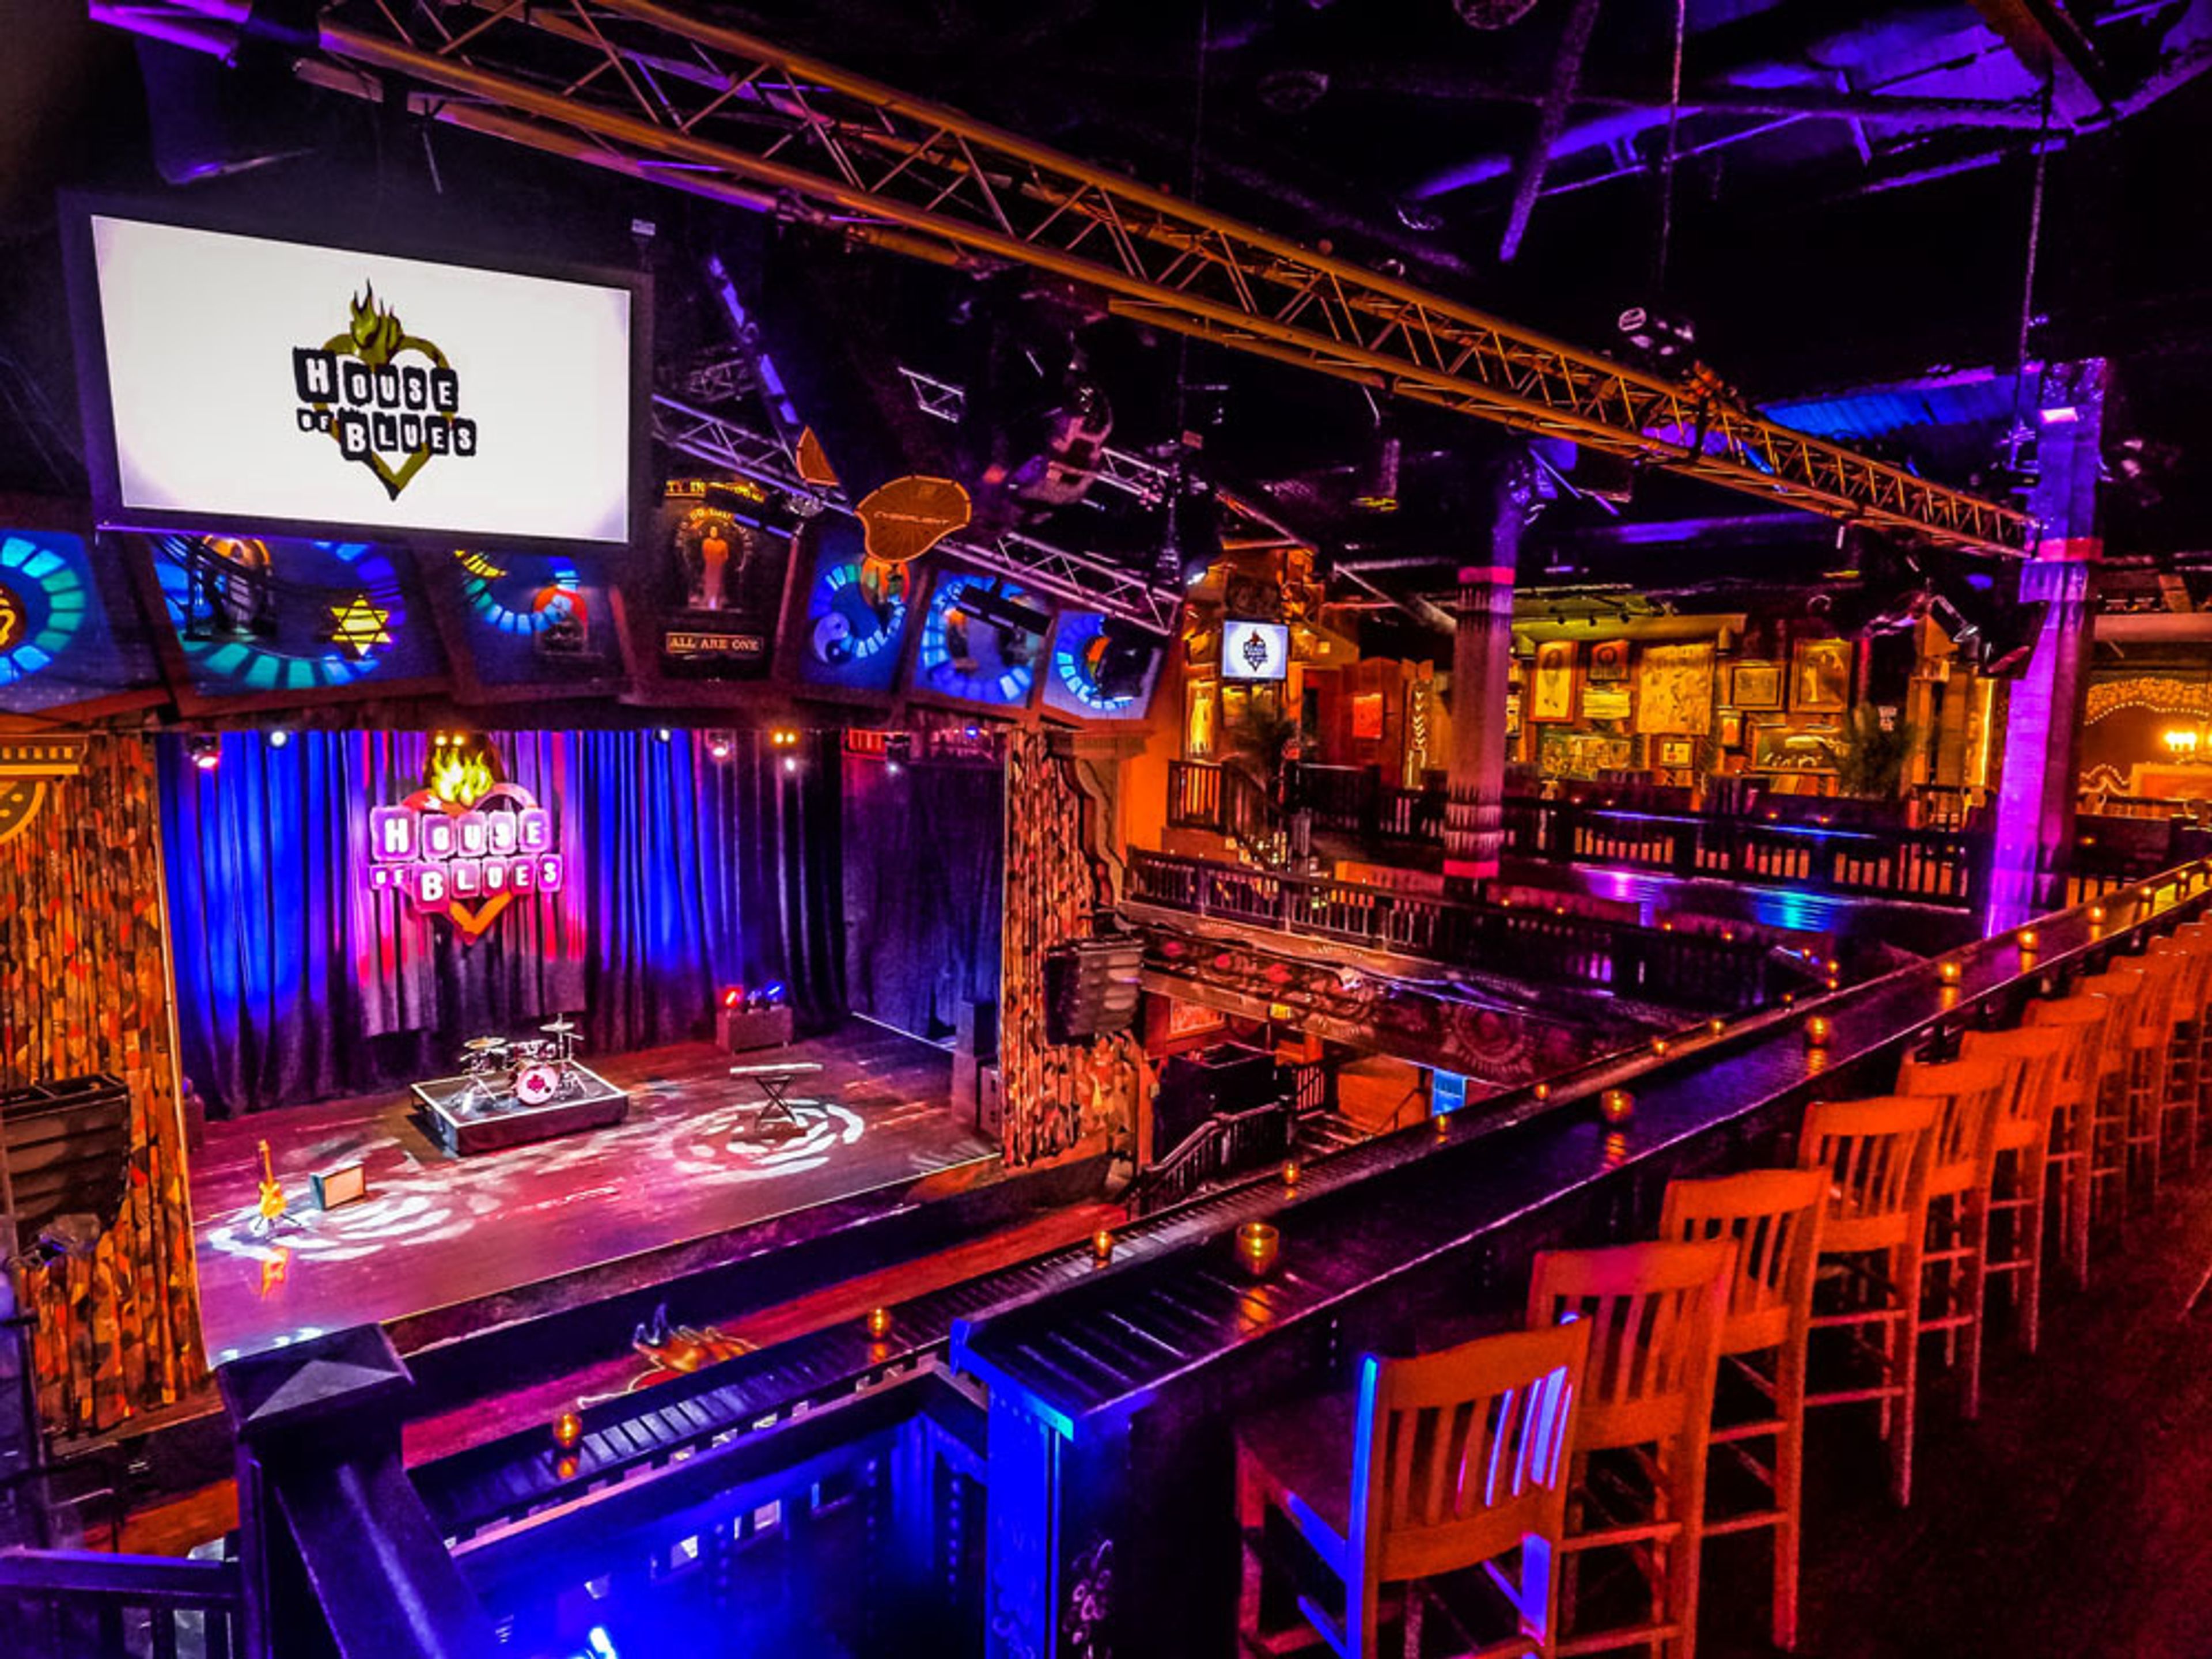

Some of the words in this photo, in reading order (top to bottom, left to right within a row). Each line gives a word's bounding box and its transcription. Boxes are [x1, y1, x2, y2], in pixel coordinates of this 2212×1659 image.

[304, 357, 453, 406] HOUSE
[300, 412, 329, 430] OF
[344, 421, 473, 453] BLUES
[669, 637, 695, 649] ALL
[701, 638, 728, 650] ARE
[732, 639, 759, 651] ONE
[383, 817, 542, 853] HOUSE
[375, 869, 404, 885] OF
[420, 861, 557, 902] BLUES
